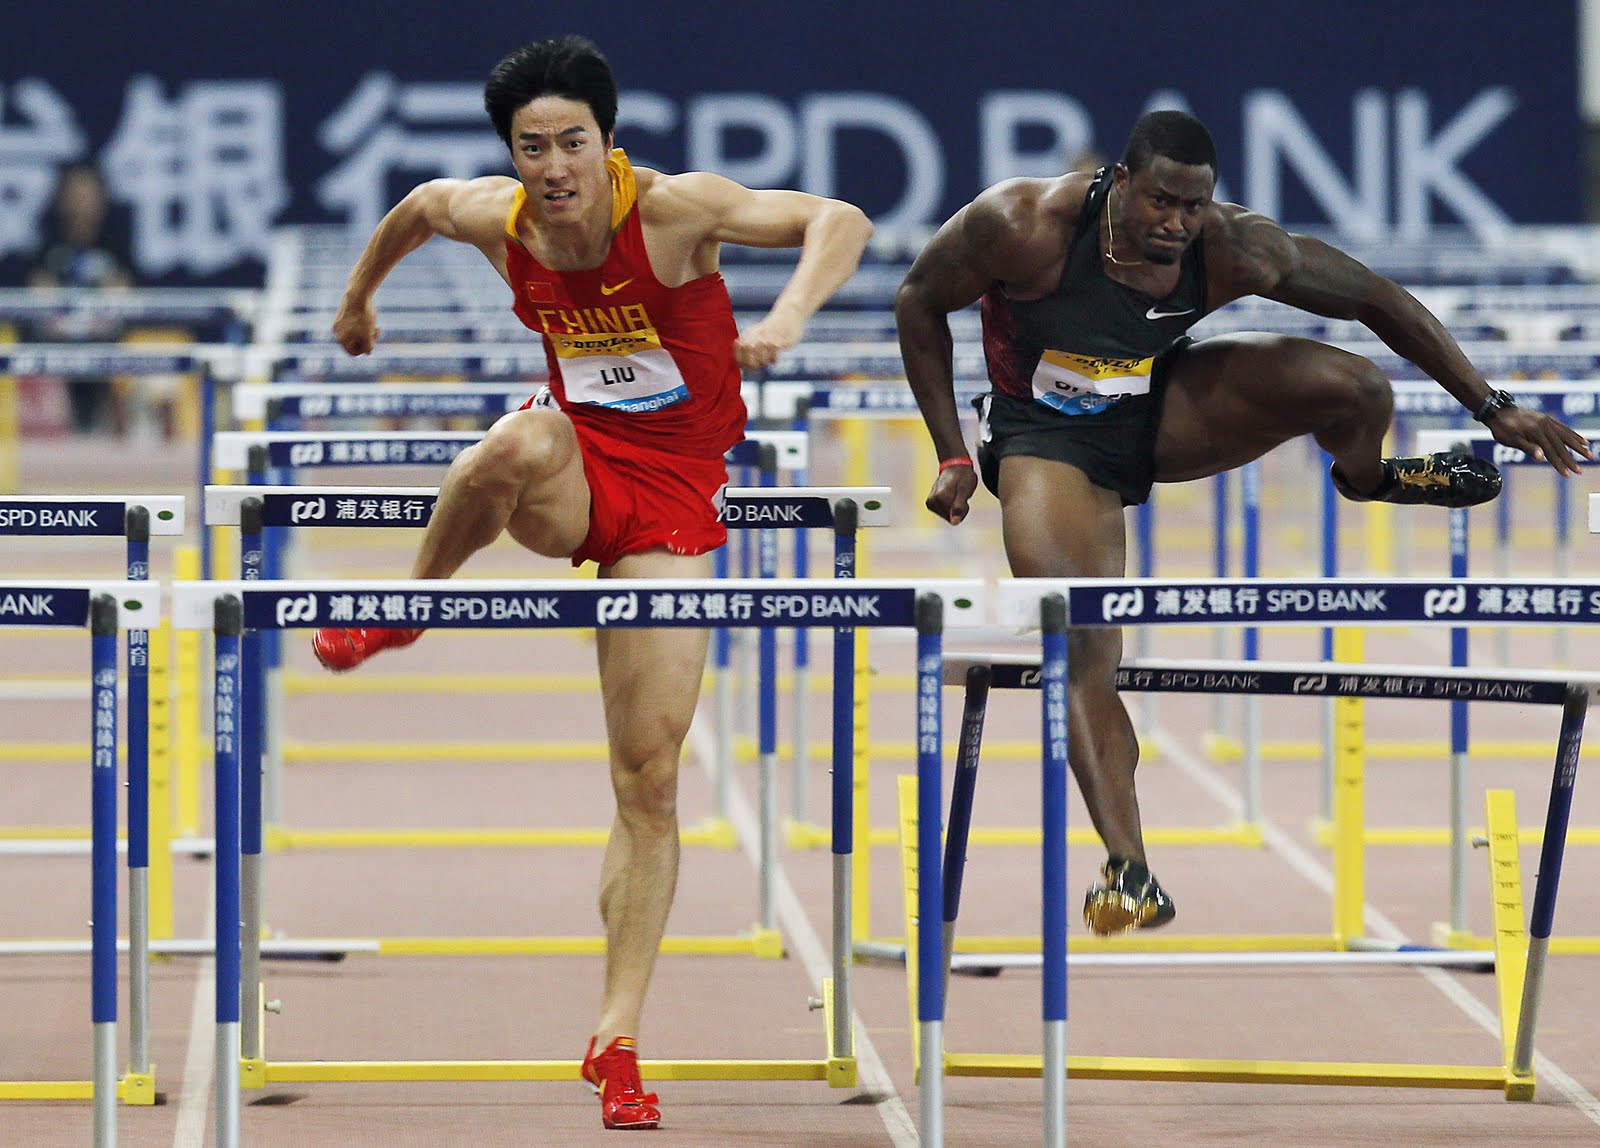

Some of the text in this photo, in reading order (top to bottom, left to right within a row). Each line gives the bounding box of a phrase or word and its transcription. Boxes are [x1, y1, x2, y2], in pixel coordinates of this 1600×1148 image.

[979, 85, 1517, 242] BNK
[536, 303, 652, 334] CHINA
[600, 366, 635, 386] LIU
[40, 509, 98, 528] BANK
[336, 499, 425, 521] 浦发银行
[745, 504, 803, 522] BANK
[0, 593, 54, 616] ANK
[329, 594, 560, 622] 浦发银行 SPD BANK
[649, 593, 880, 621] 浦发银行 SPD BANK
[1154, 588, 1388, 615] 浦发银行 SPD BANK
[1476, 587, 1583, 615] 浦发银行
[1160, 672, 1199, 688] SPD
[1203, 673, 1260, 689] BANK
[1433, 680, 1472, 696] SPD
[1476, 682, 1535, 699] BANK
